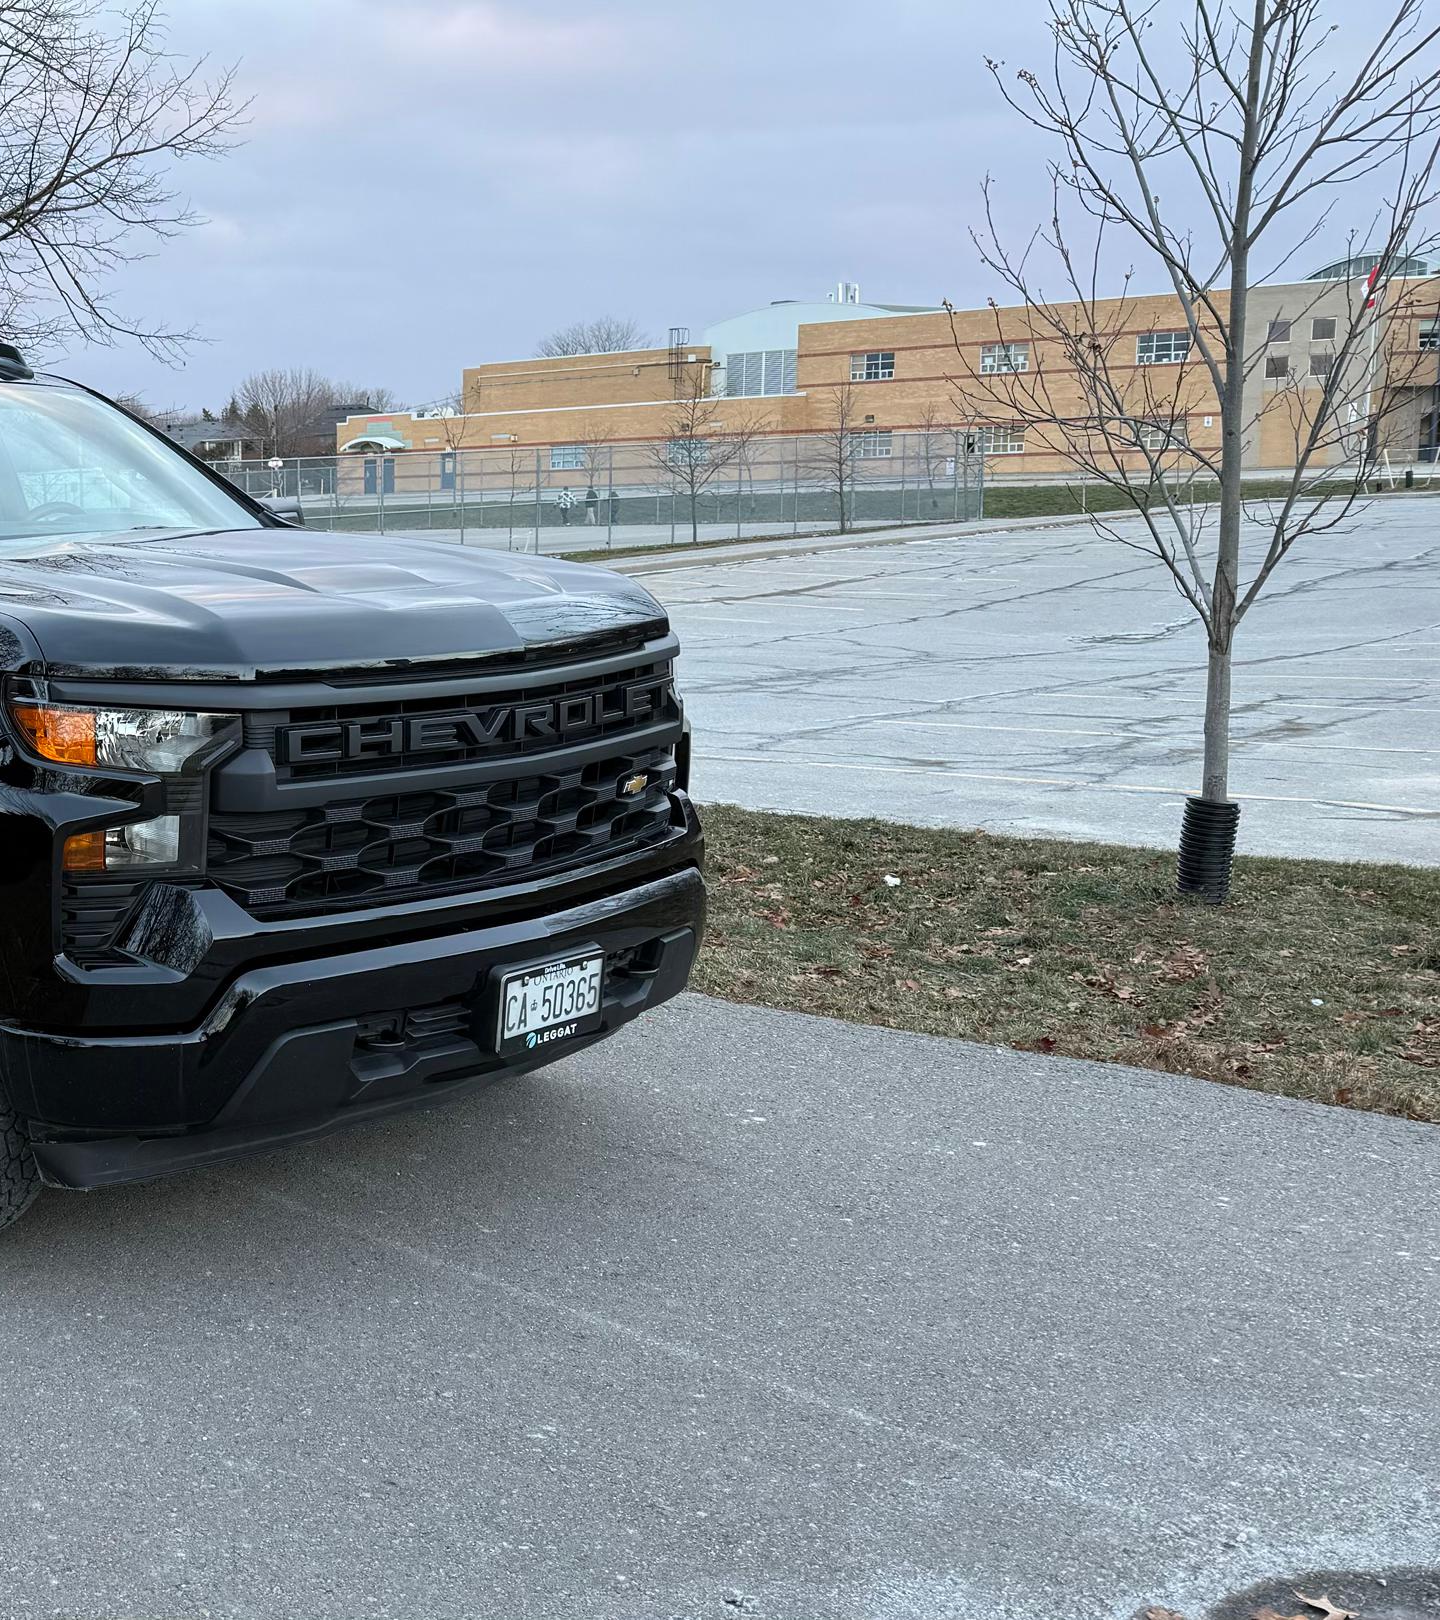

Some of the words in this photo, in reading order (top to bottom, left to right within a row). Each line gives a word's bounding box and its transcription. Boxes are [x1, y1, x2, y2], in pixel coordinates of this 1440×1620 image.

[506, 992, 528, 1032] CA
[541, 973, 599, 1022] 50365
[537, 1023, 578, 1044] LEGGAT
